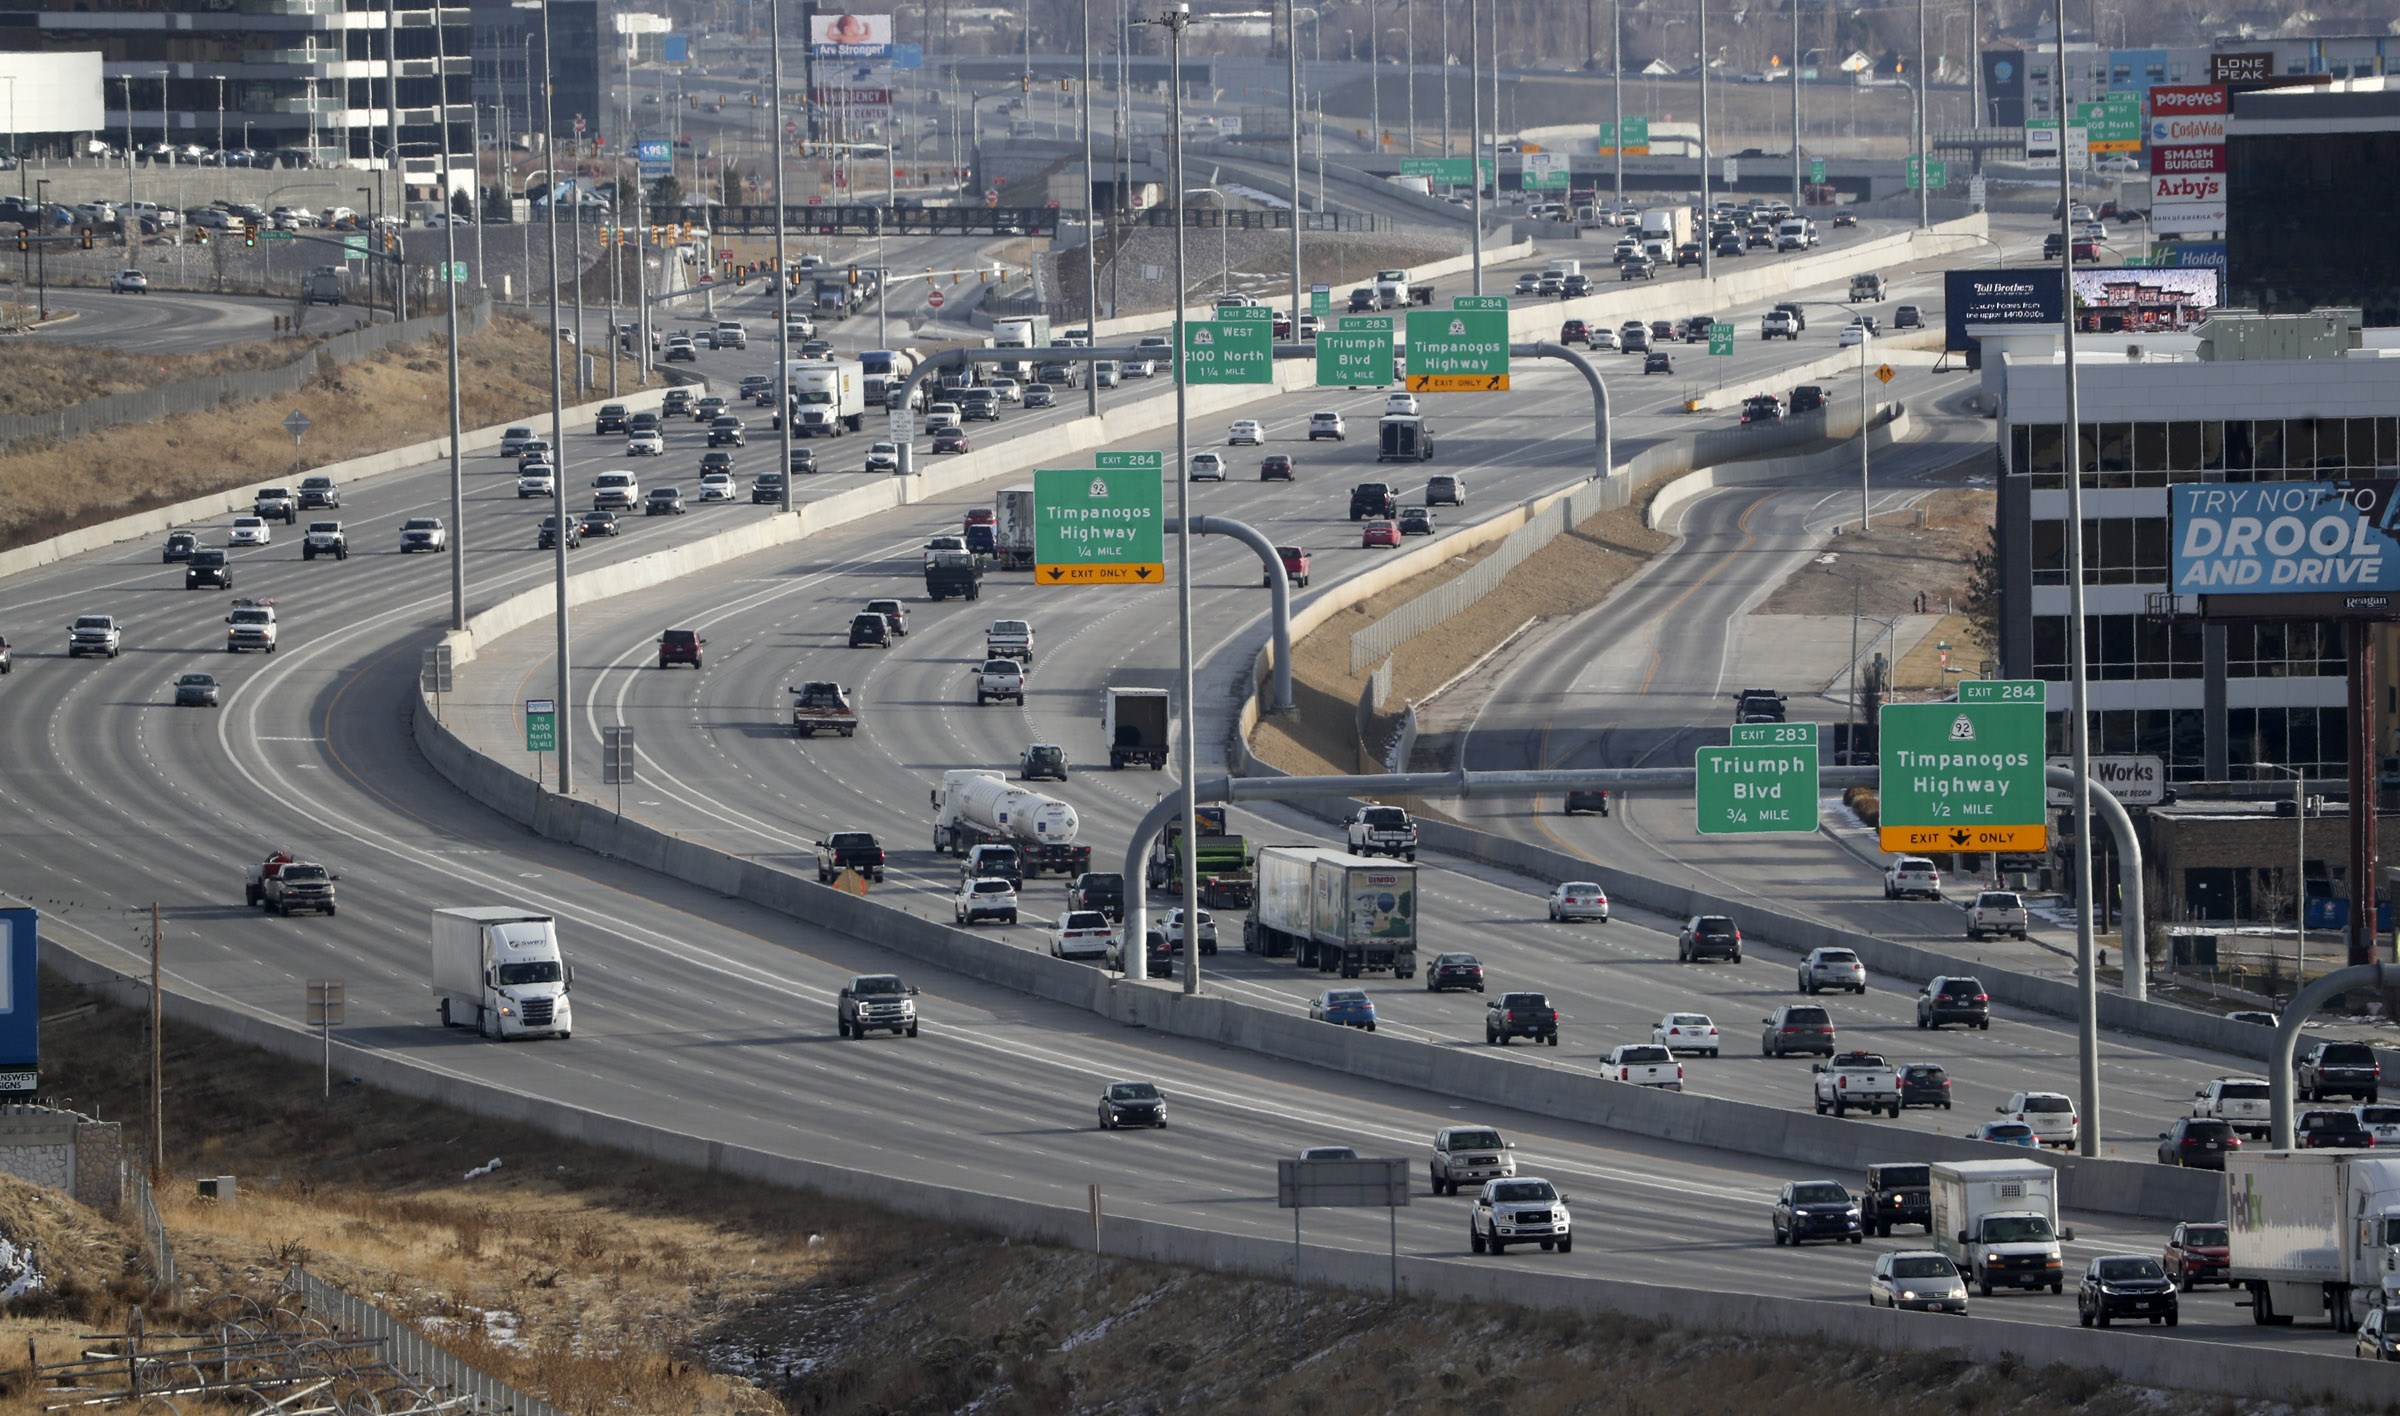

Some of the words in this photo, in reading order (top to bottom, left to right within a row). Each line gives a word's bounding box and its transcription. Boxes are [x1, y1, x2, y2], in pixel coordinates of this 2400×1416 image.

[2217, 58, 2264, 68] LONE
[2217, 69, 2263, 80] PEAK
[2164, 148, 2213, 160] SMASH
[2164, 160, 2213, 170] BURGER
[2156, 176, 2219, 200] Arby's
[1974, 283, 1993, 293] Toll
[1994, 283, 2034, 293] Brothers
[1480, 299, 1502, 308] 284
[1245, 309, 1266, 318] 282
[1344, 320, 1360, 328] EXIT
[1366, 320, 1388, 329] 283
[1452, 322, 1462, 331] 92
[1713, 325, 1730, 333] EXIT
[1223, 327, 1253, 337] WEST
[1711, 333, 1732, 342] 284
[1325, 337, 1385, 351] Triumph
[1415, 341, 1500, 355] Timpanogos
[1224, 350, 1264, 361] North
[1339, 354, 1371, 365] Blvd
[1425, 358, 1489, 371] Highway
[1354, 371, 1374, 379] MILE
[1434, 379, 1453, 387] EXIT
[1458, 379, 1481, 387] ONLY
[1128, 455, 1155, 465] 284
[1093, 484, 1105, 492] 92
[2188, 489, 2248, 513] TRY
[2256, 488, 2327, 512] NOT
[2337, 488, 2377, 512] TO
[1046, 506, 1151, 521] Timpanogos
[1060, 526, 1137, 542] Highway
[2181, 515, 2381, 558] DROOL
[1097, 547, 1122, 555] MILE
[1071, 569, 1093, 578] EXIT
[1100, 569, 1128, 577] ONLY
[2180, 559, 2263, 586] AND
[2270, 557, 2383, 585] DRIVE
[2345, 597, 2388, 608] Reagan
[1968, 687, 1992, 697] EXIT
[2002, 685, 2036, 698] 284
[531, 723, 550, 731] 2100
[1955, 722, 1970, 733] 92
[1741, 730, 1765, 740] EXIT
[1775, 728, 1808, 741] 283
[1710, 756, 1805, 775] Triumph
[1897, 751, 2029, 771] Timpanogos
[2098, 762, 2154, 782] Works
[1733, 782, 1781, 799] Blvd
[1914, 776, 2011, 797] Highway
[2129, 789, 2152, 797] DECOR
[1759, 809, 1790, 820] MILE
[1963, 804, 1993, 815] MILE
[1910, 833, 1939, 844] EXIT
[1979, 833, 2015, 843] ONLY
[2229, 1173, 2264, 1234] FedEx
